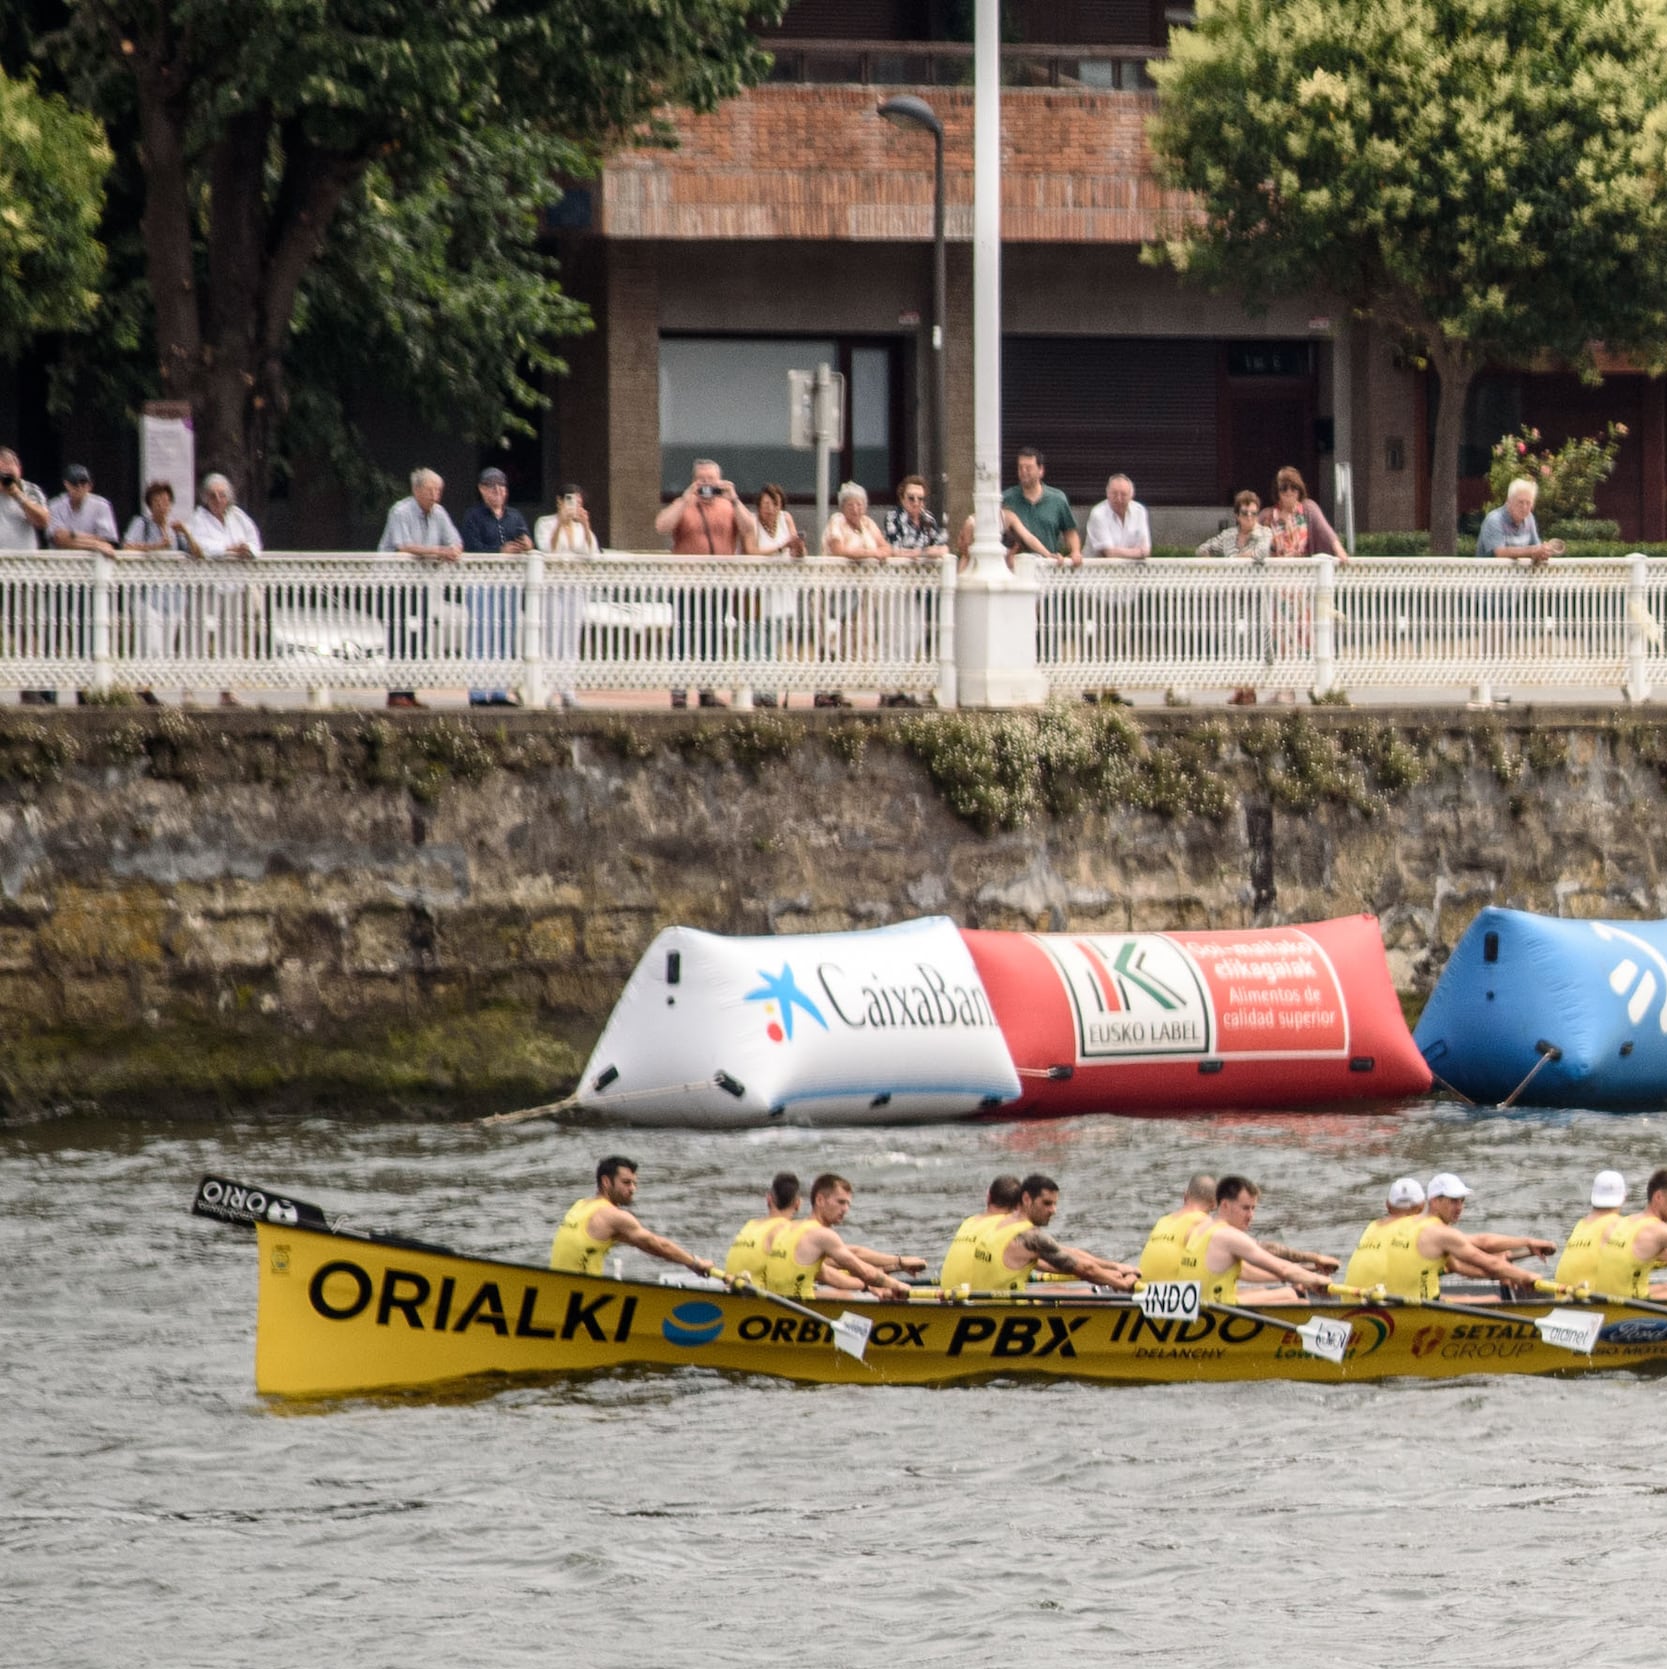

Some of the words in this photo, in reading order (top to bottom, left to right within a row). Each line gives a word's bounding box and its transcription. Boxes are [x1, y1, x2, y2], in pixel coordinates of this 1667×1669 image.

[1213, 957, 1317, 983] elikagaiak
[817, 961, 997, 1032] CaixaBan
[1229, 985, 1299, 1004] Alimentos
[1303, 986, 1321, 1001] de
[1089, 1023, 1145, 1044] EUSKO
[1151, 1020, 1200, 1041] LABEL
[1223, 1008, 1274, 1027] calidad
[1278, 1008, 1335, 1031] superior
[203, 1181, 267, 1213] ORIO
[309, 1261, 638, 1343] ORIALKI
[1145, 1284, 1198, 1313] INDO
[946, 1316, 1091, 1357] PBX
[1135, 1347, 1227, 1359] DELANCHY
[1440, 1342, 1535, 1360] GROUP
